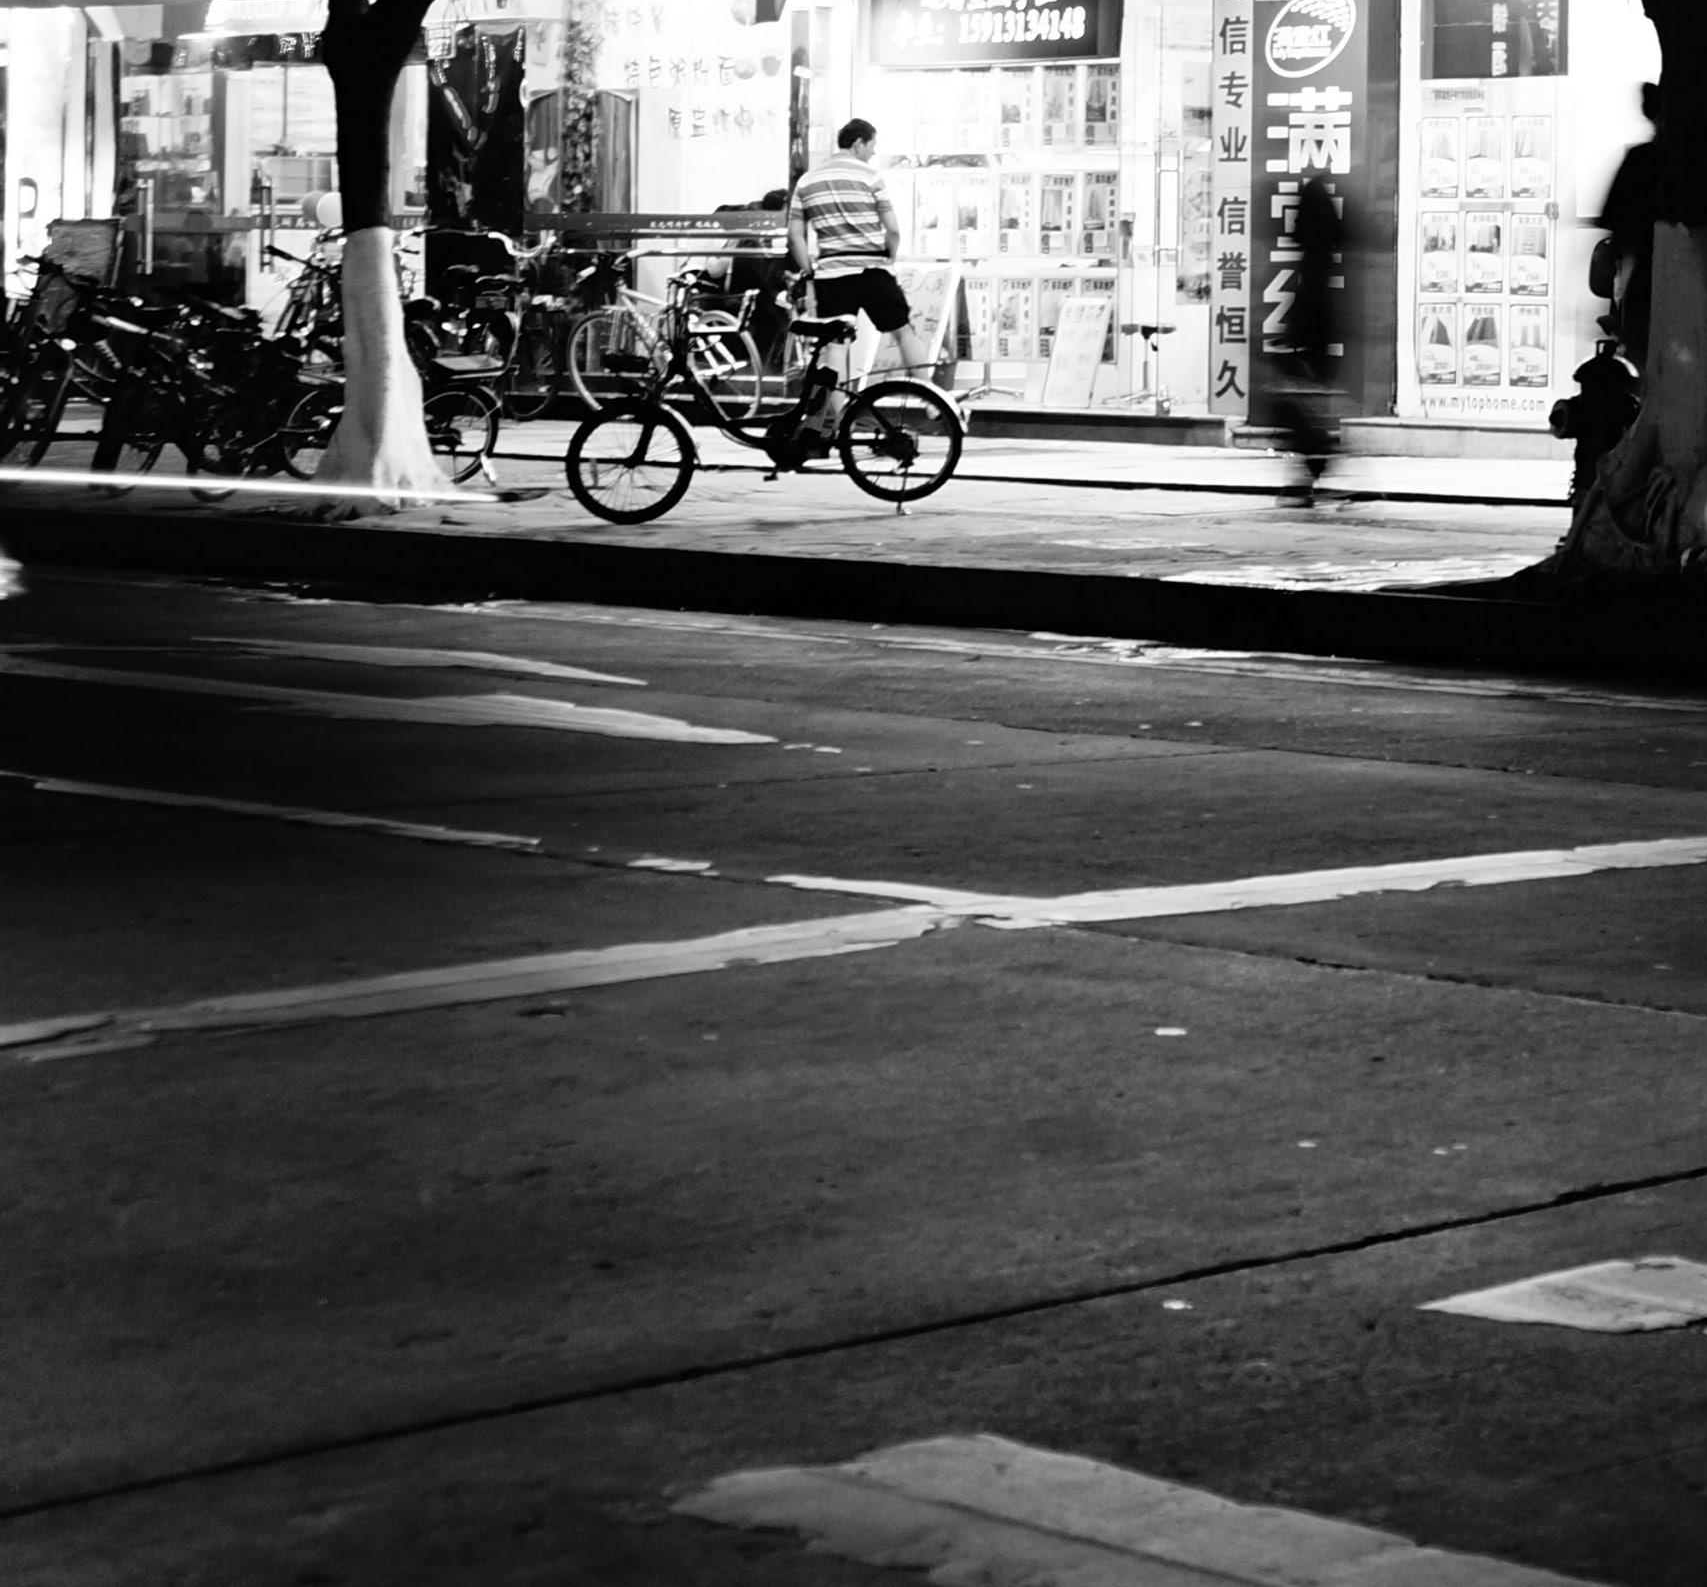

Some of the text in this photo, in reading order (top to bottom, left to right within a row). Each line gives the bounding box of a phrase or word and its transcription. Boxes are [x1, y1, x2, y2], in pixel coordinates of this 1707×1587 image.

[958, 5, 1086, 45] 15913134148
[1213, 195, 1249, 399] 信誉恒久
[1420, 393, 1547, 413] www.mytophome.com
